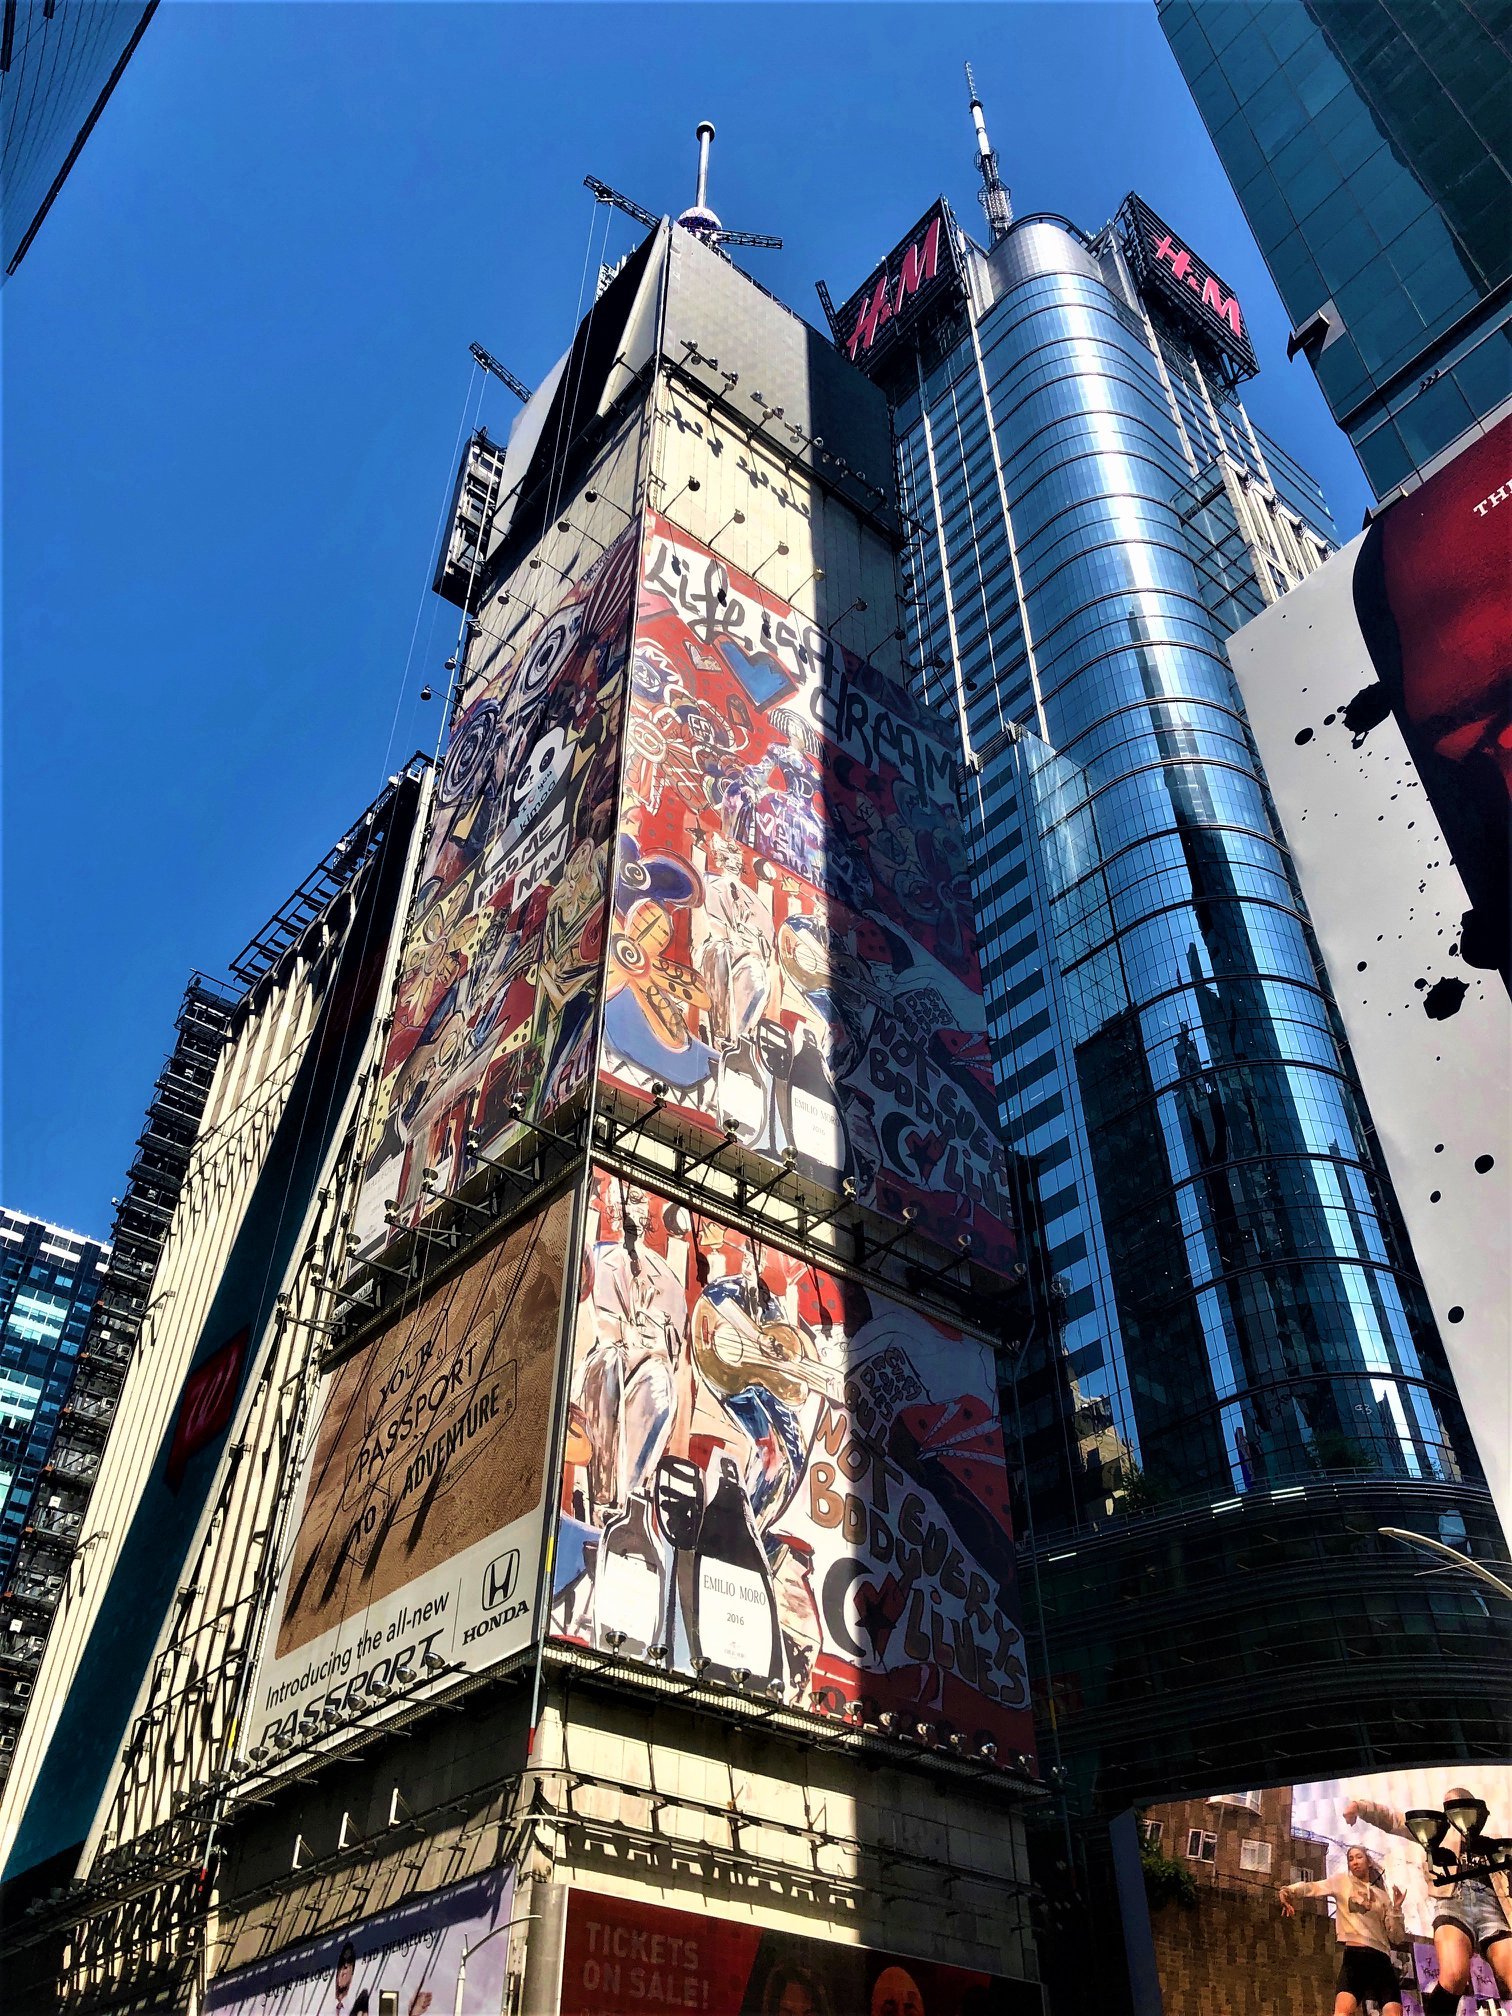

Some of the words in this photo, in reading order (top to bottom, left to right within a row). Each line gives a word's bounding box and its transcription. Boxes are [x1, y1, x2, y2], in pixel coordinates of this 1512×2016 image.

[846, 216, 941, 361] H&M
[1153, 233, 1243, 338] H&M
[794, 1097, 819, 1116] EMILIO
[820, 1110, 841, 1128] MORO
[358, 1342, 478, 1482] PASSPORT
[379, 1338, 432, 1403] YOUR
[352, 1504, 376, 1545] TO
[403, 1383, 500, 1500] ADVENTURE
[815, 1412, 904, 1515] NOT
[806, 1461, 921, 1597] BODY
[461, 1600, 530, 1646] HONDA
[703, 1574, 736, 1597] EMILIO
[739, 1585, 766, 1606] MORO
[726, 1612, 745, 1626] 2016
[260, 1628, 445, 1749] PASSPORT
[265, 1646, 352, 1711] Introducing
[356, 1629, 382, 1660] the
[386, 1591, 450, 1643] all-new
[361, 1948, 380, 1965] AND
[582, 1959, 621, 1996] ON
[628, 1966, 710, 2010] SALE!
[585, 1921, 699, 1971] TICKETS
